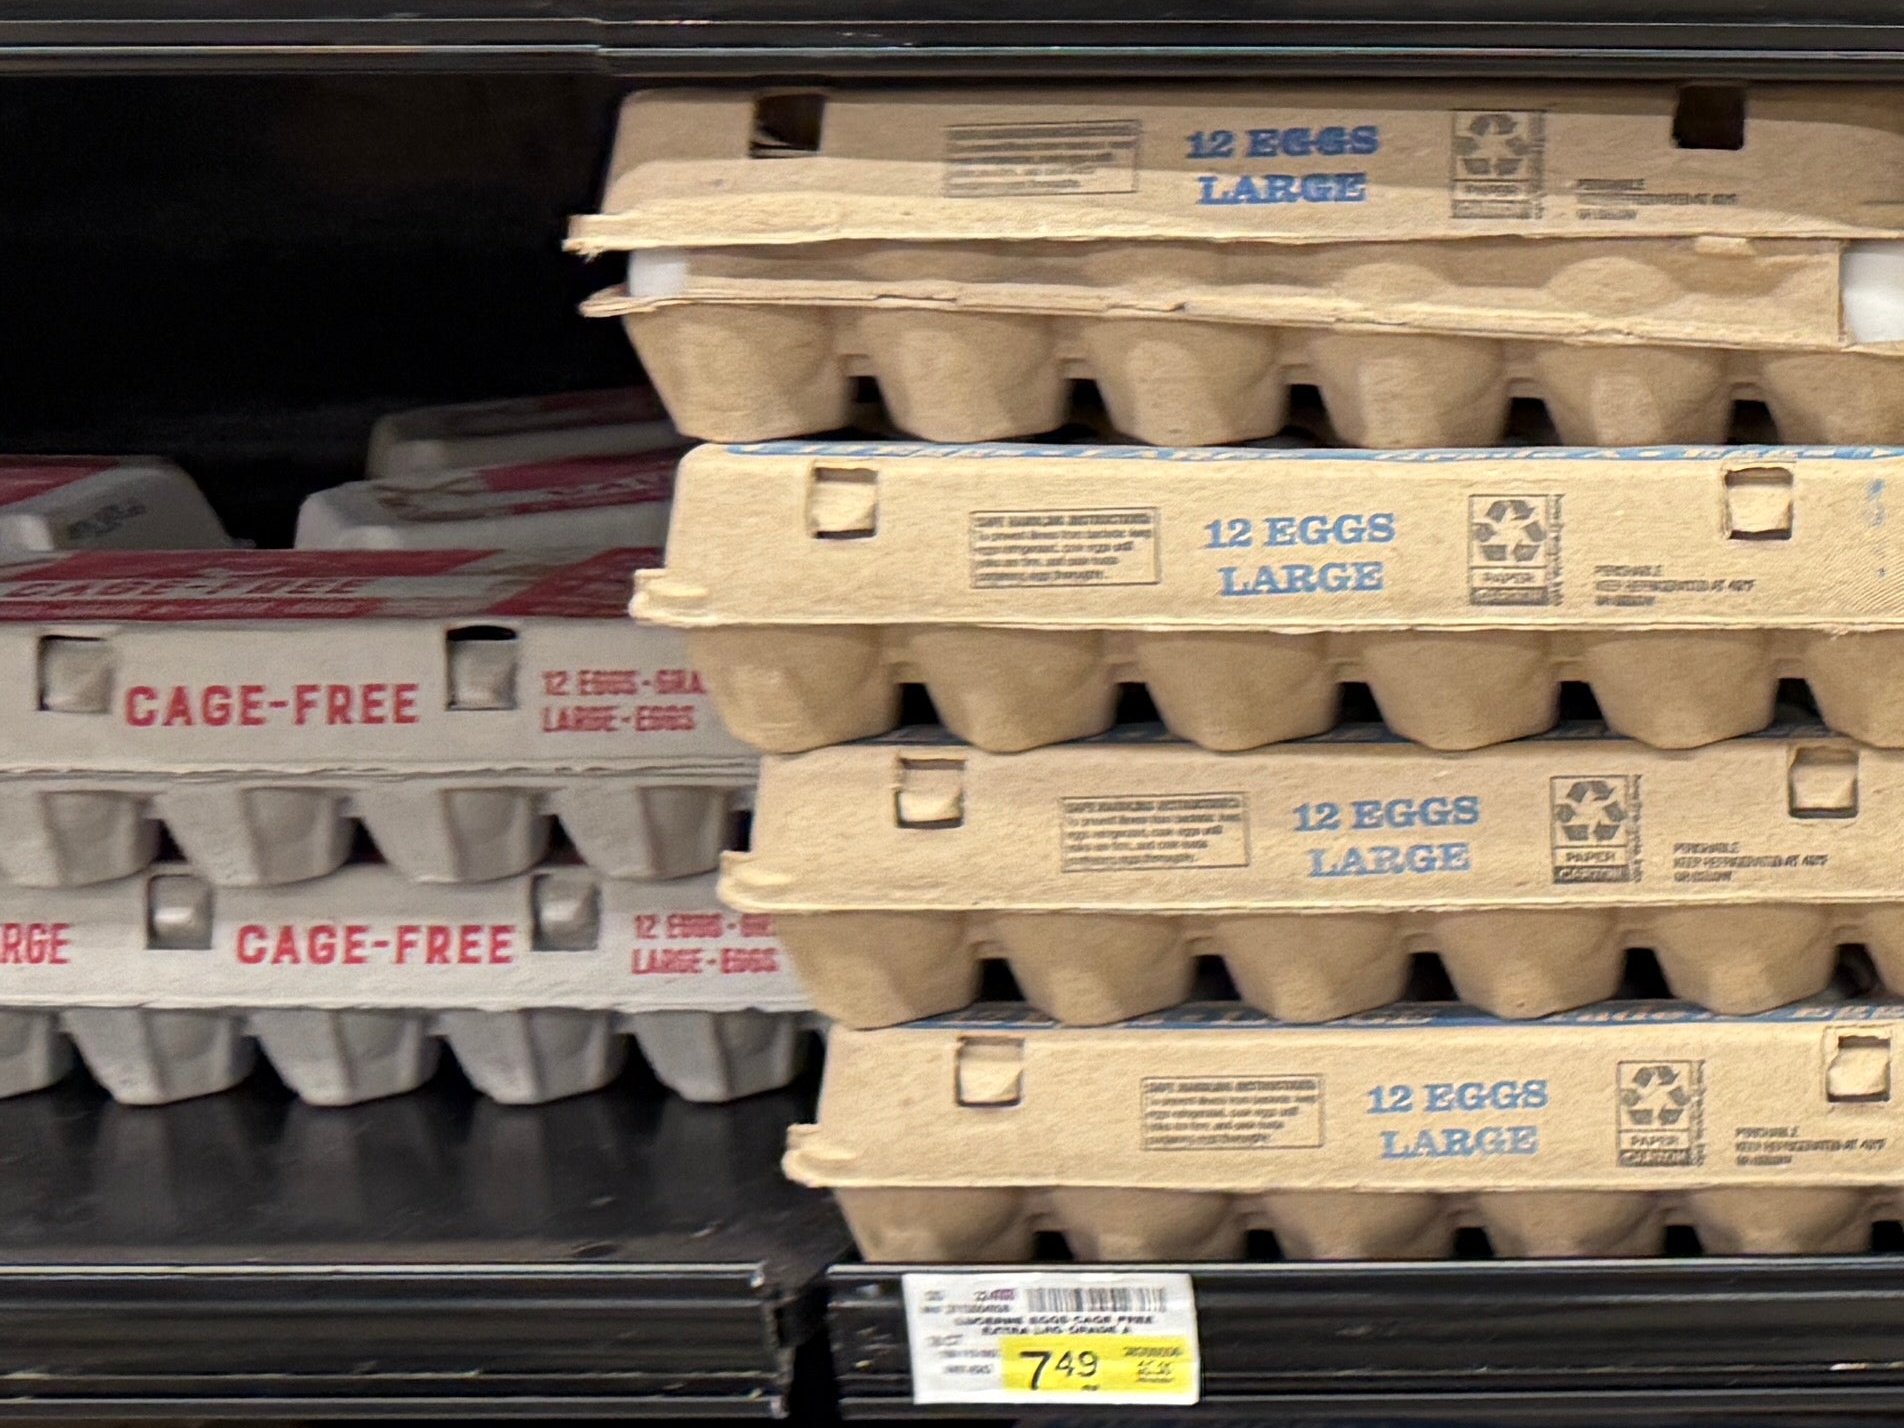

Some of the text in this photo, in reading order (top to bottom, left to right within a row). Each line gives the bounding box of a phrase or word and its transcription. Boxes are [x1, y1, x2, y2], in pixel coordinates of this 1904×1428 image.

[1203, 513, 1396, 550] 12 EGGS
[1217, 561, 1385, 597] LARGE
[124, 683, 420, 729] CAGE-FREE
[235, 924, 516, 967] CAGE-FREE
[1366, 1080, 1549, 1114] 12 EGGS
[1379, 1125, 1540, 1160] LARGE
